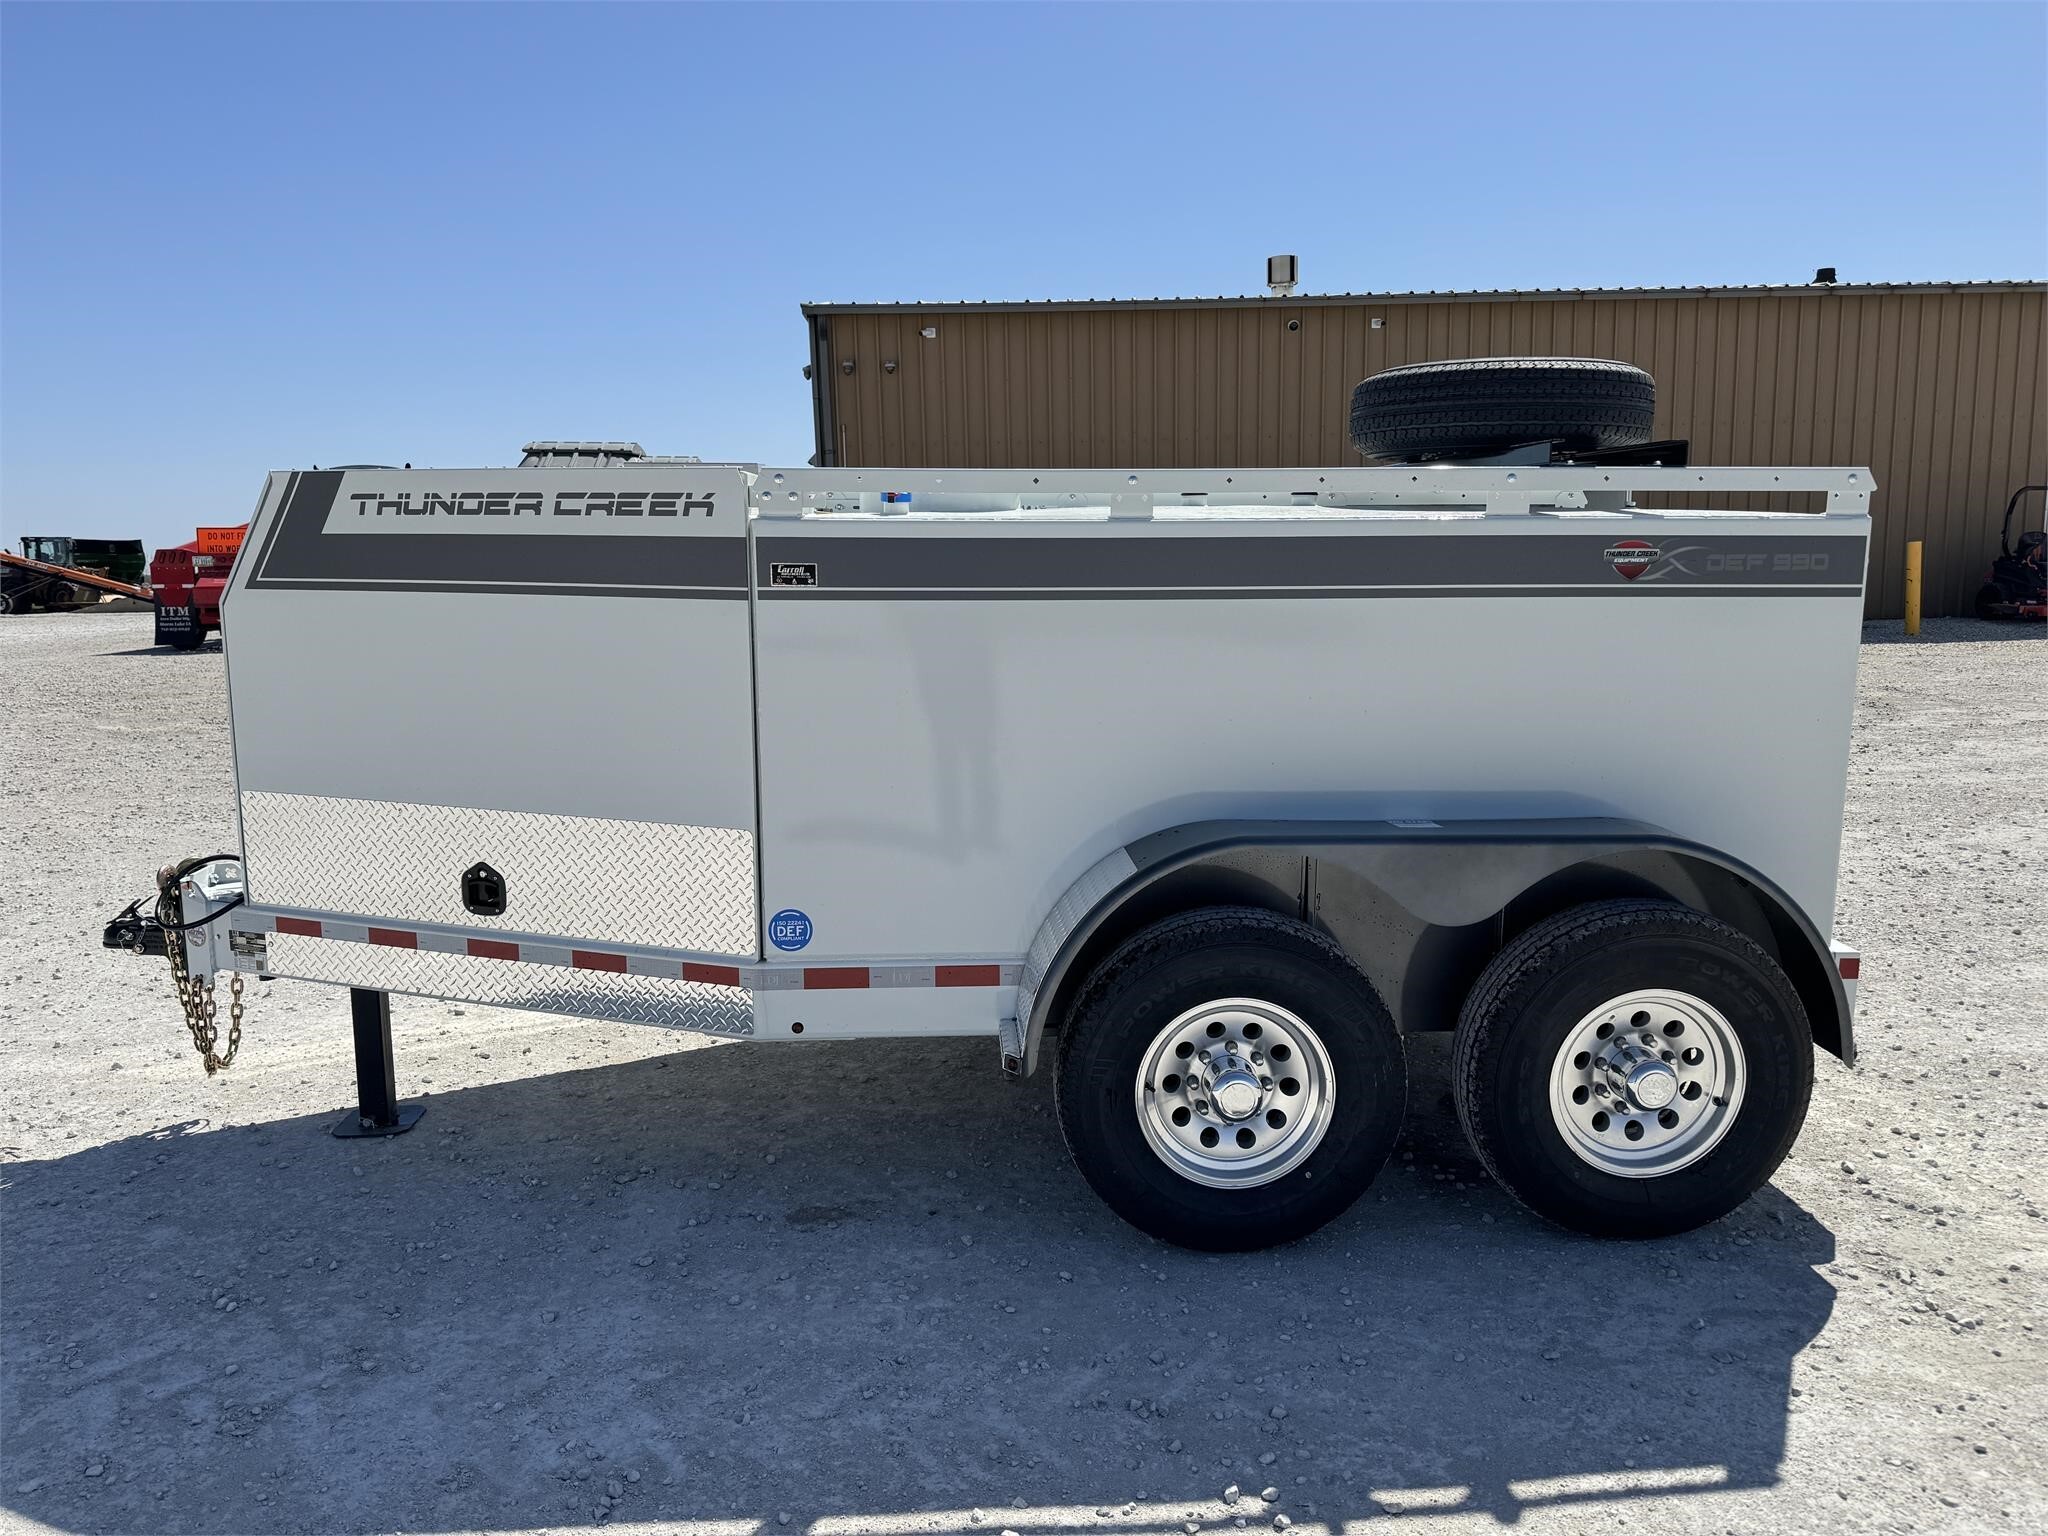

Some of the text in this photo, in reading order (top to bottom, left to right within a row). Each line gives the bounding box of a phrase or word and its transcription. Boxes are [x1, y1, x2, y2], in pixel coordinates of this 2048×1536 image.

[350, 492, 716, 517] THUNDER CREEK
[207, 532, 218, 541] DO
[221, 532, 234, 541] NOT
[207, 544, 223, 553] INTO
[1706, 553, 1829, 571] DEF 990
[160, 606, 190, 616] ITM
[777, 926, 805, 937] DEF
